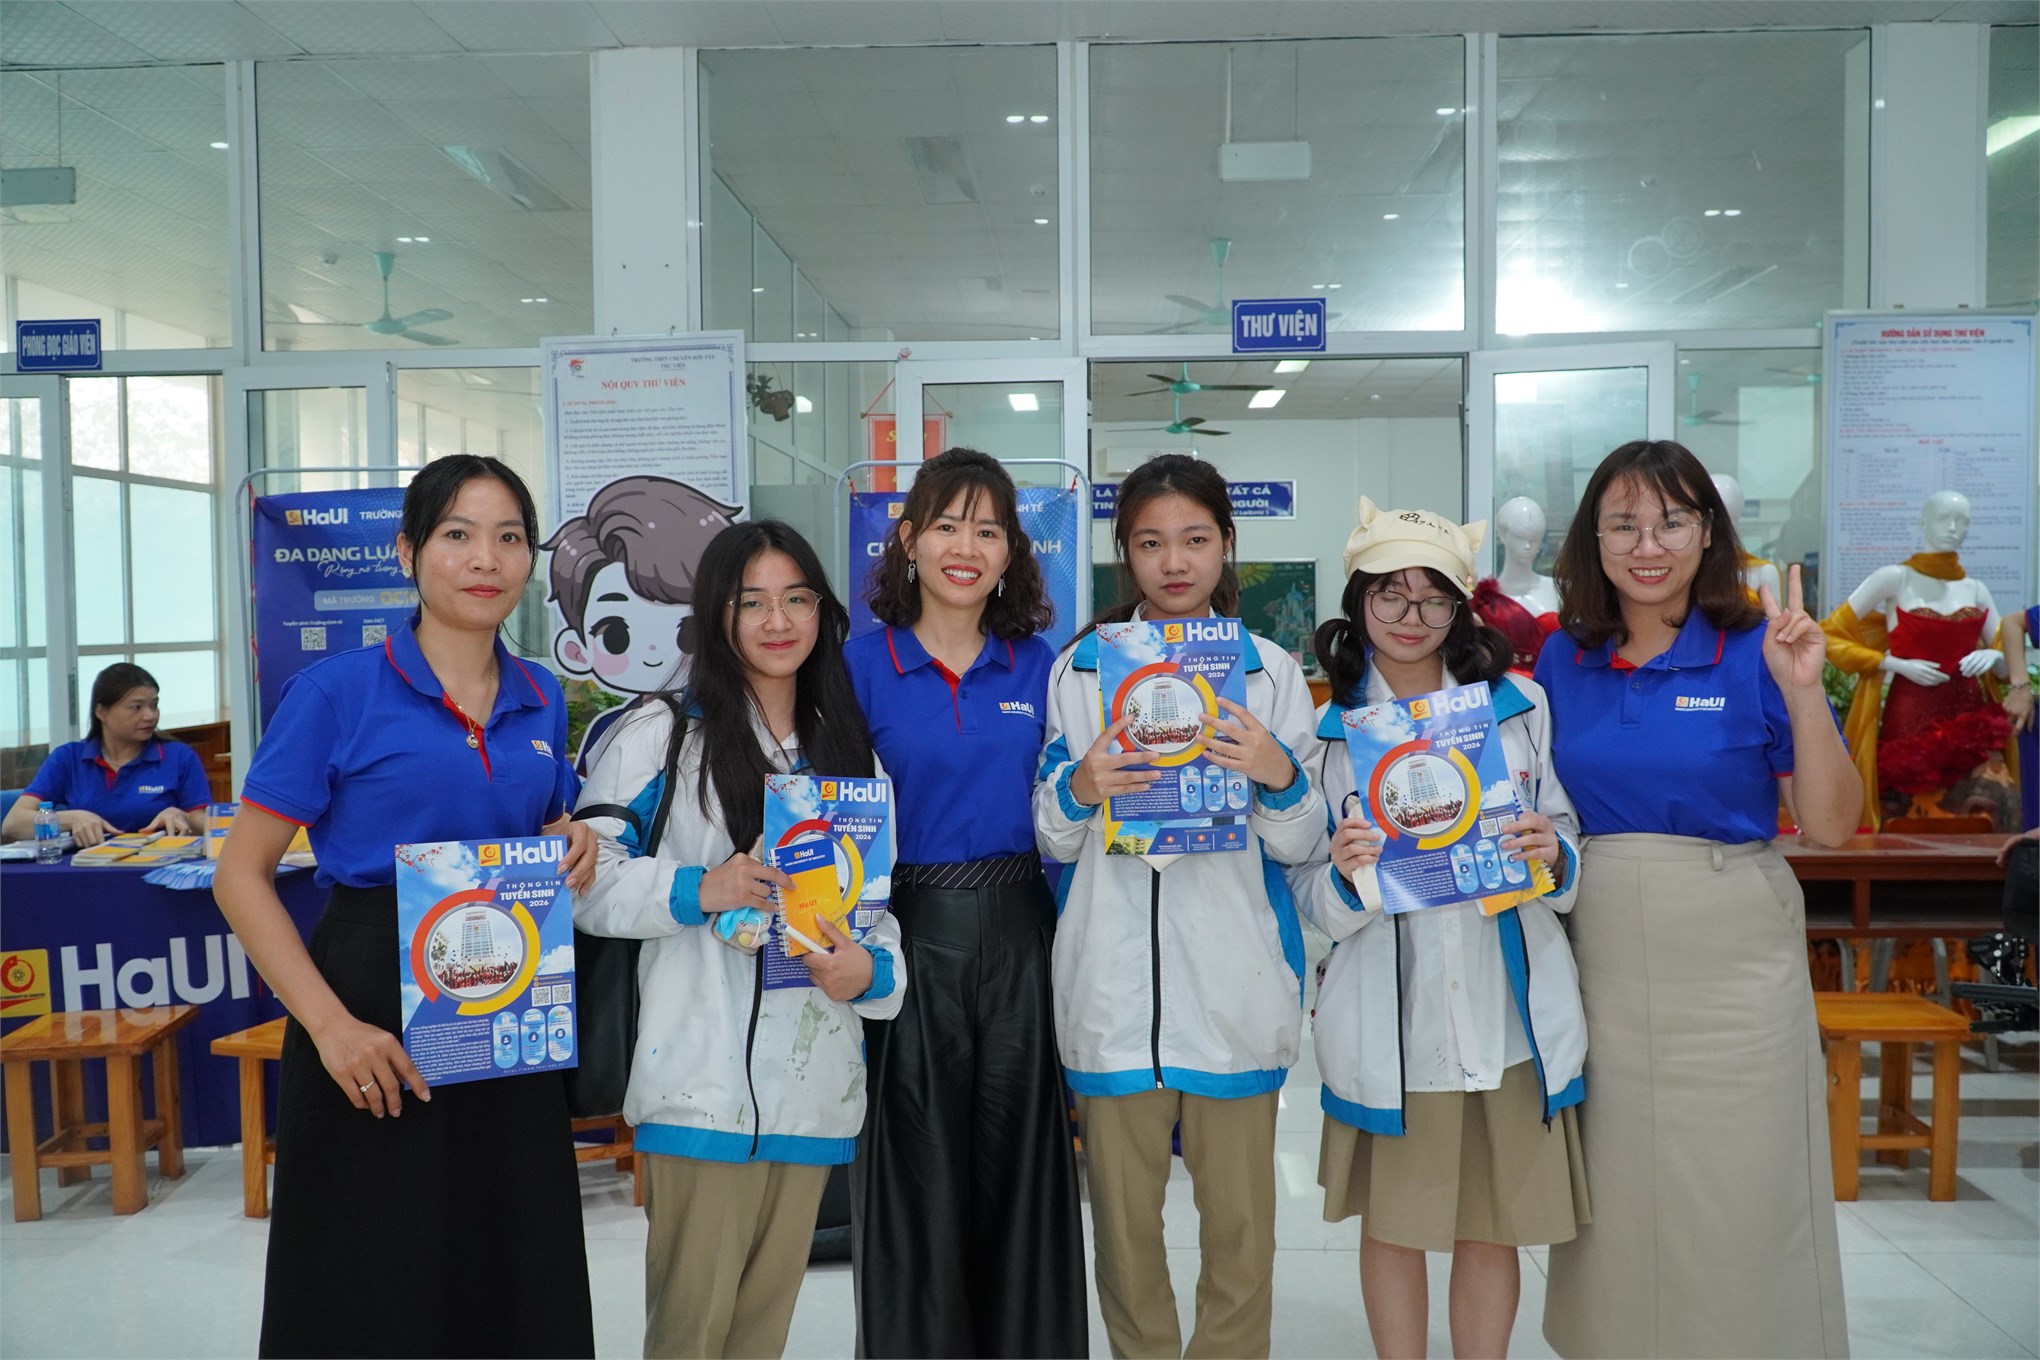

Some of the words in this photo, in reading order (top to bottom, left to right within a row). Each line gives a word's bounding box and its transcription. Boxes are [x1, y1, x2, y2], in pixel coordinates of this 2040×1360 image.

[1241, 313, 1275, 338] THƯ
[1278, 309, 1318, 341] VIỆN
[601, 380, 618, 390] NỘI
[620, 380, 639, 390] QUY
[643, 379, 662, 388] THƯ
[663, 377, 686, 388] VIỆN
[1252, 484, 1272, 496] CẢ
[303, 508, 349, 525] HaUI
[274, 548, 305, 562] ĐA
[306, 546, 361, 563] DẠNG
[1186, 622, 1239, 642] HaUI
[1183, 662, 1209, 673] TUYỂN
[1210, 663, 1230, 671] SINH
[1432, 686, 1489, 716] HaUI
[1689, 696, 1726, 707] HaUI
[1440, 727, 1471, 737] THÔNG
[1464, 731, 1485, 742] SINH
[840, 781, 887, 803] HaUI
[833, 823, 857, 832] TUYỂN
[857, 825, 877, 833] SINH
[504, 840, 564, 865] HaUI
[532, 889, 554, 898] SINH
[60, 934, 250, 1012] HaUI
